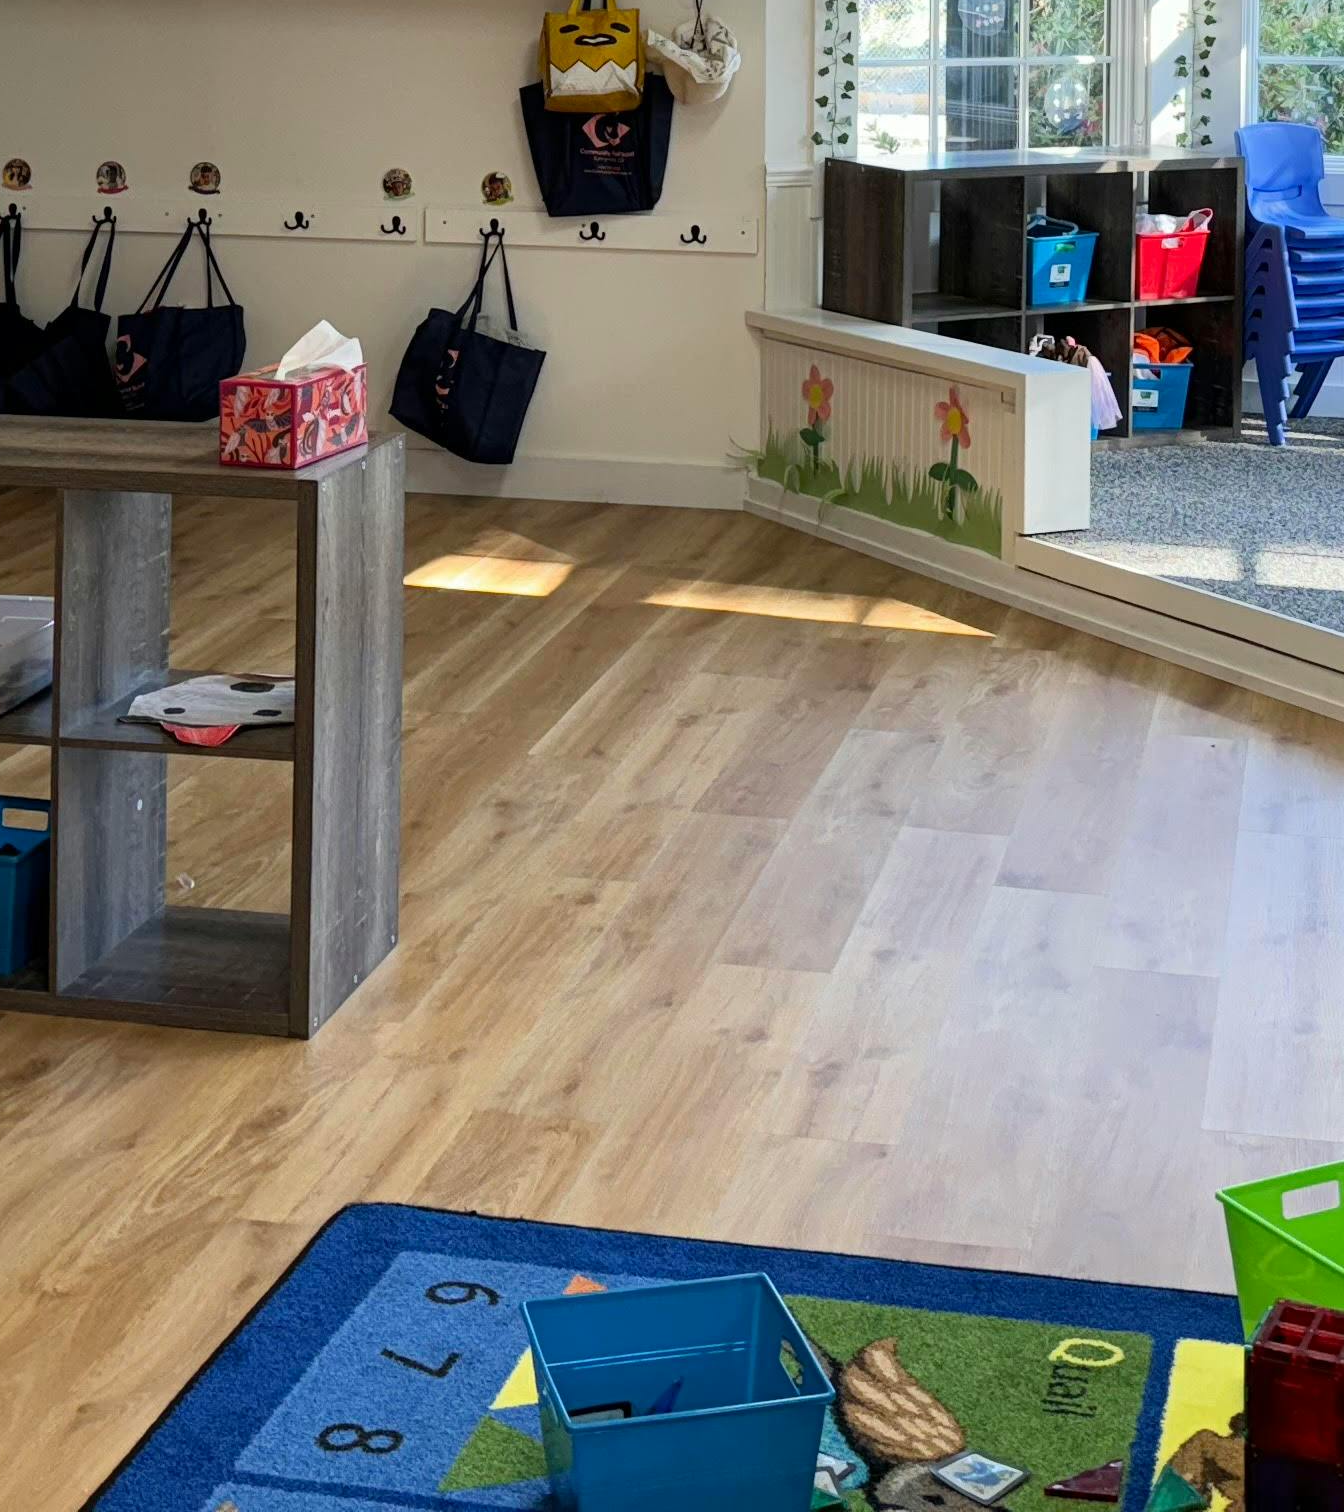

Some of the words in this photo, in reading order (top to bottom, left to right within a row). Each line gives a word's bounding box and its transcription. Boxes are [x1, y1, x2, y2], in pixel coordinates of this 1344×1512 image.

[381, 1348, 462, 1378] 7
[1041, 1338, 1125, 1418] Quail
[314, 1423, 404, 1454] 8
